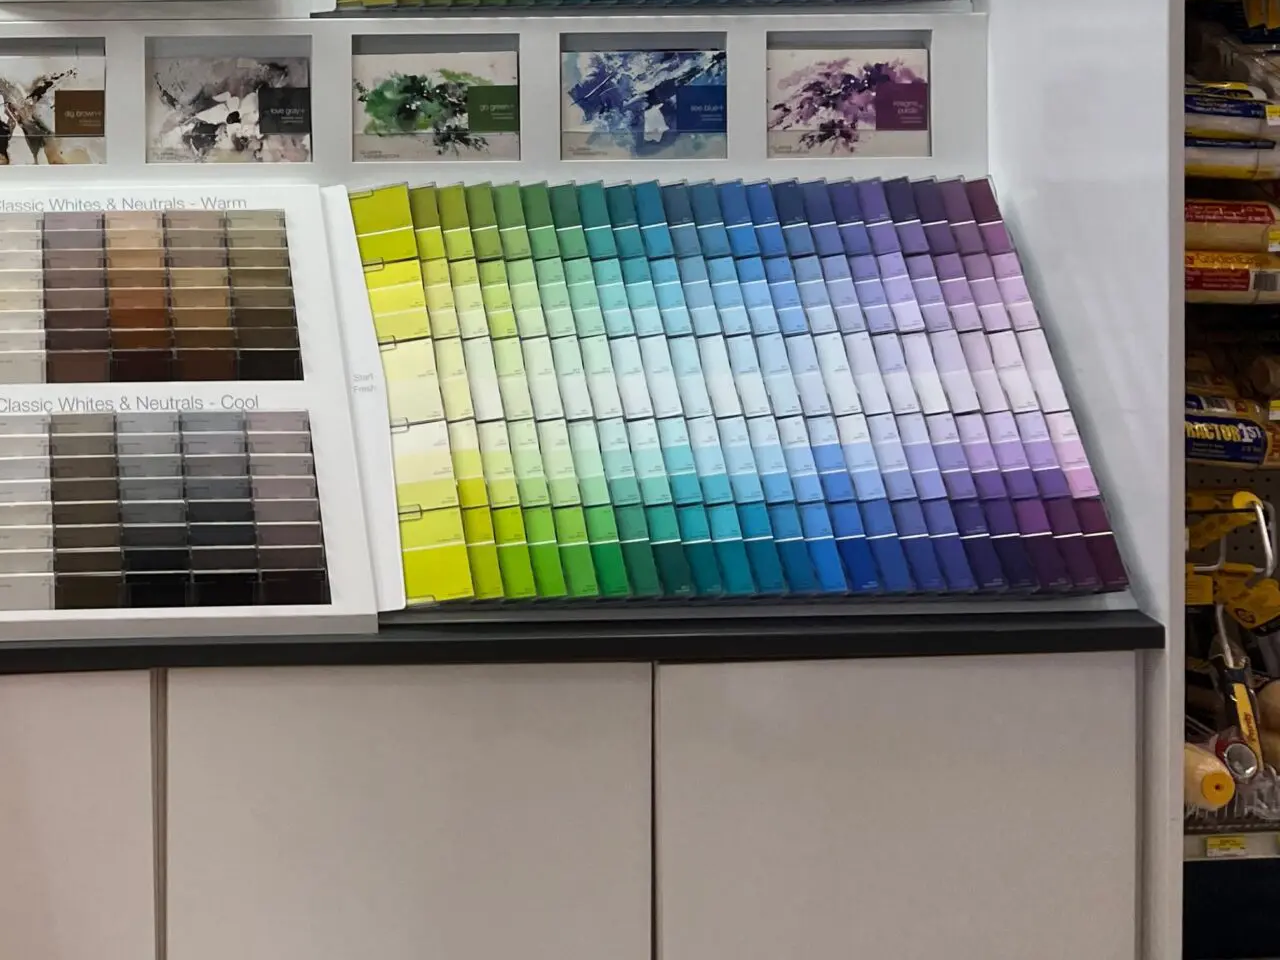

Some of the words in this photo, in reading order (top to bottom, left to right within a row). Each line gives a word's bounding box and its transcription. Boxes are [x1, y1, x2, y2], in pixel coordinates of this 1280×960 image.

[49, 198, 101, 211] Whites
[106, 198, 117, 211] &
[122, 198, 186, 210] Neutrals
[200, 197, 248, 210] Warm
[57, 397, 114, 411] Whites
[119, 397, 131, 411] &
[136, 397, 204, 411] Neutrals
[221, 395, 259, 410] Cool
